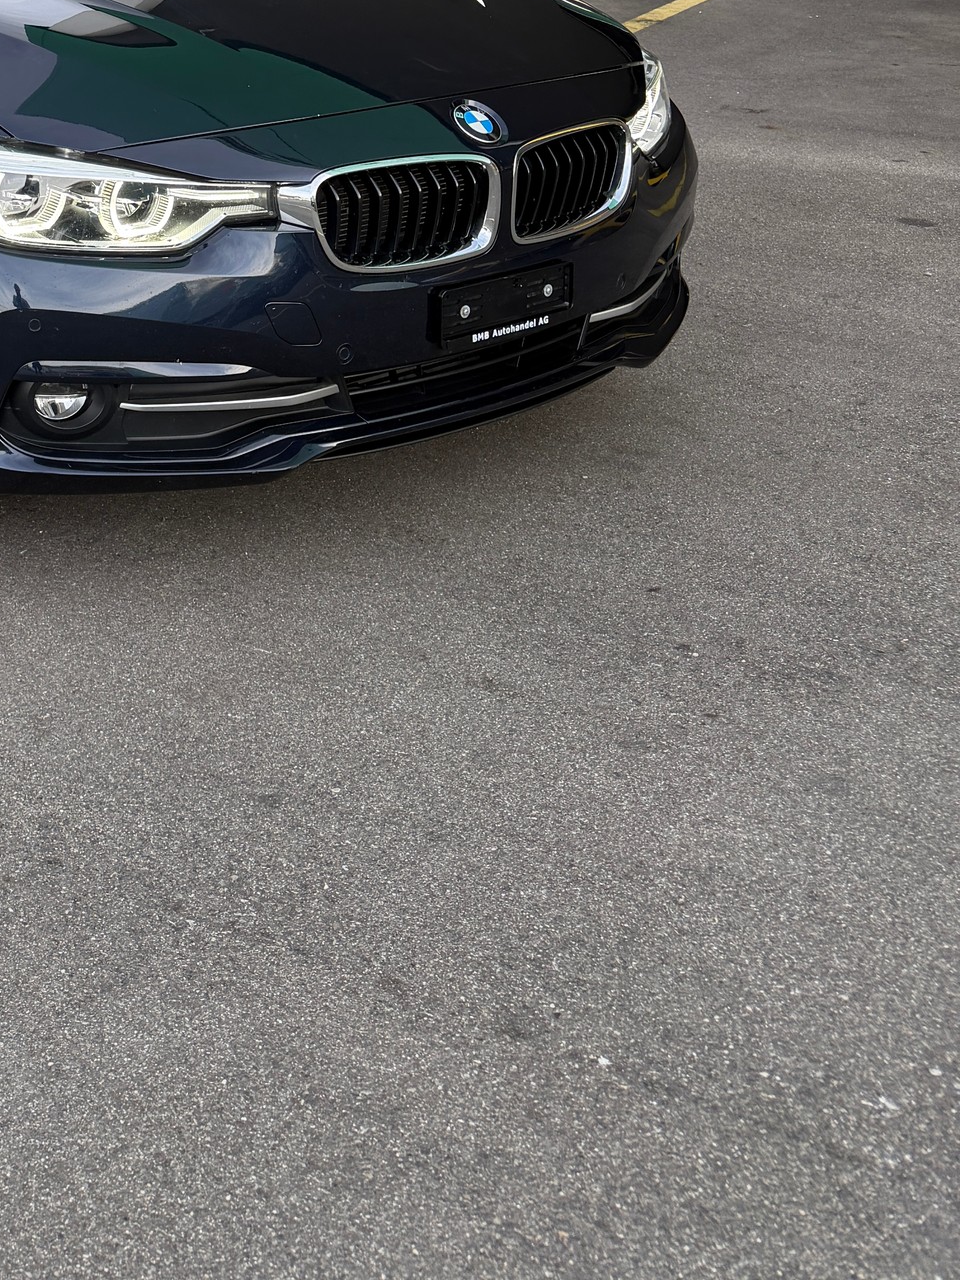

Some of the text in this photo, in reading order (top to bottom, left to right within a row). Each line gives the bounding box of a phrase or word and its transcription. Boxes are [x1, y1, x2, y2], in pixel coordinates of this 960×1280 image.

[472, 315, 549, 343] BMB Autohandel AG
